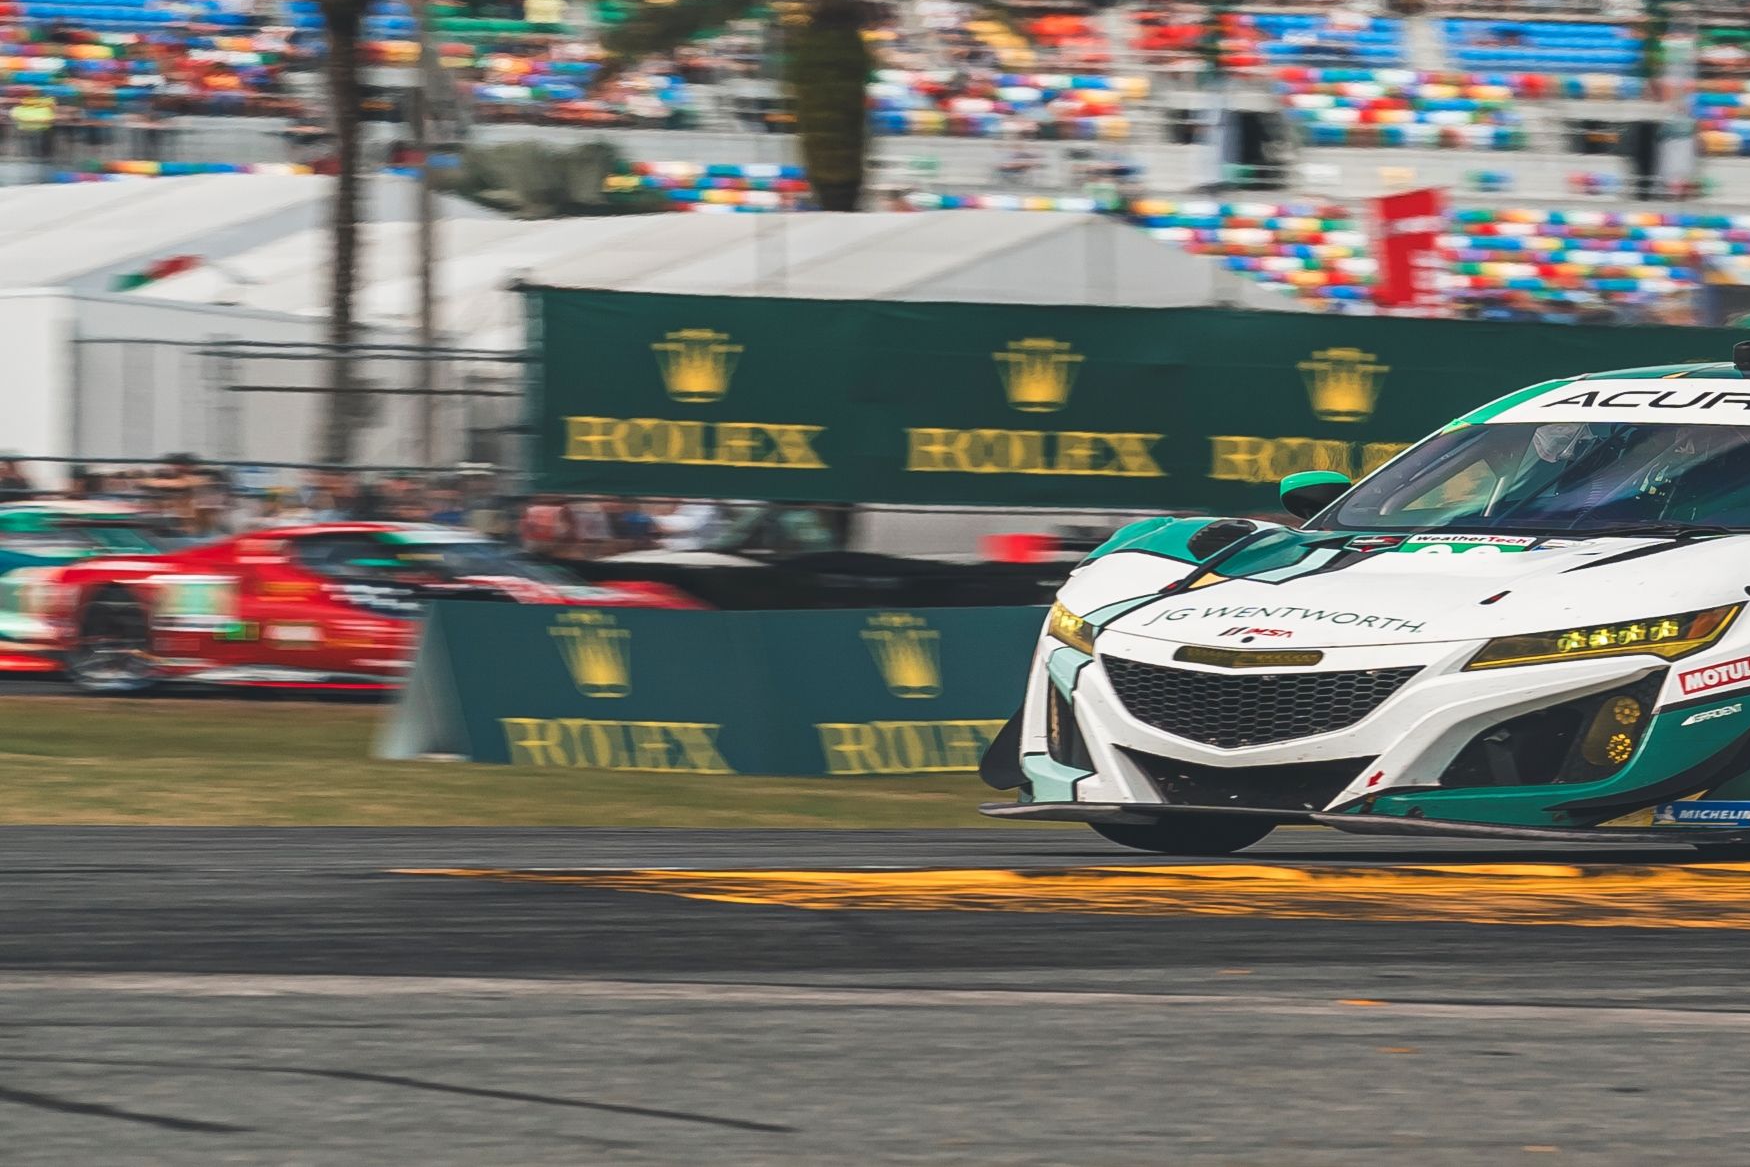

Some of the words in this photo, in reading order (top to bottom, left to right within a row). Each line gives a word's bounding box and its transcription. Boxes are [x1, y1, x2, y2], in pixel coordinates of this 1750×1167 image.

[562, 415, 829, 469] ROLEX
[905, 427, 1168, 477] ROLEX
[1416, 534, 1529, 545] WeatherTech
[1141, 607, 1197, 627] JG
[497, 716, 737, 774] ROLEX
[814, 719, 1008, 775] ROLE
